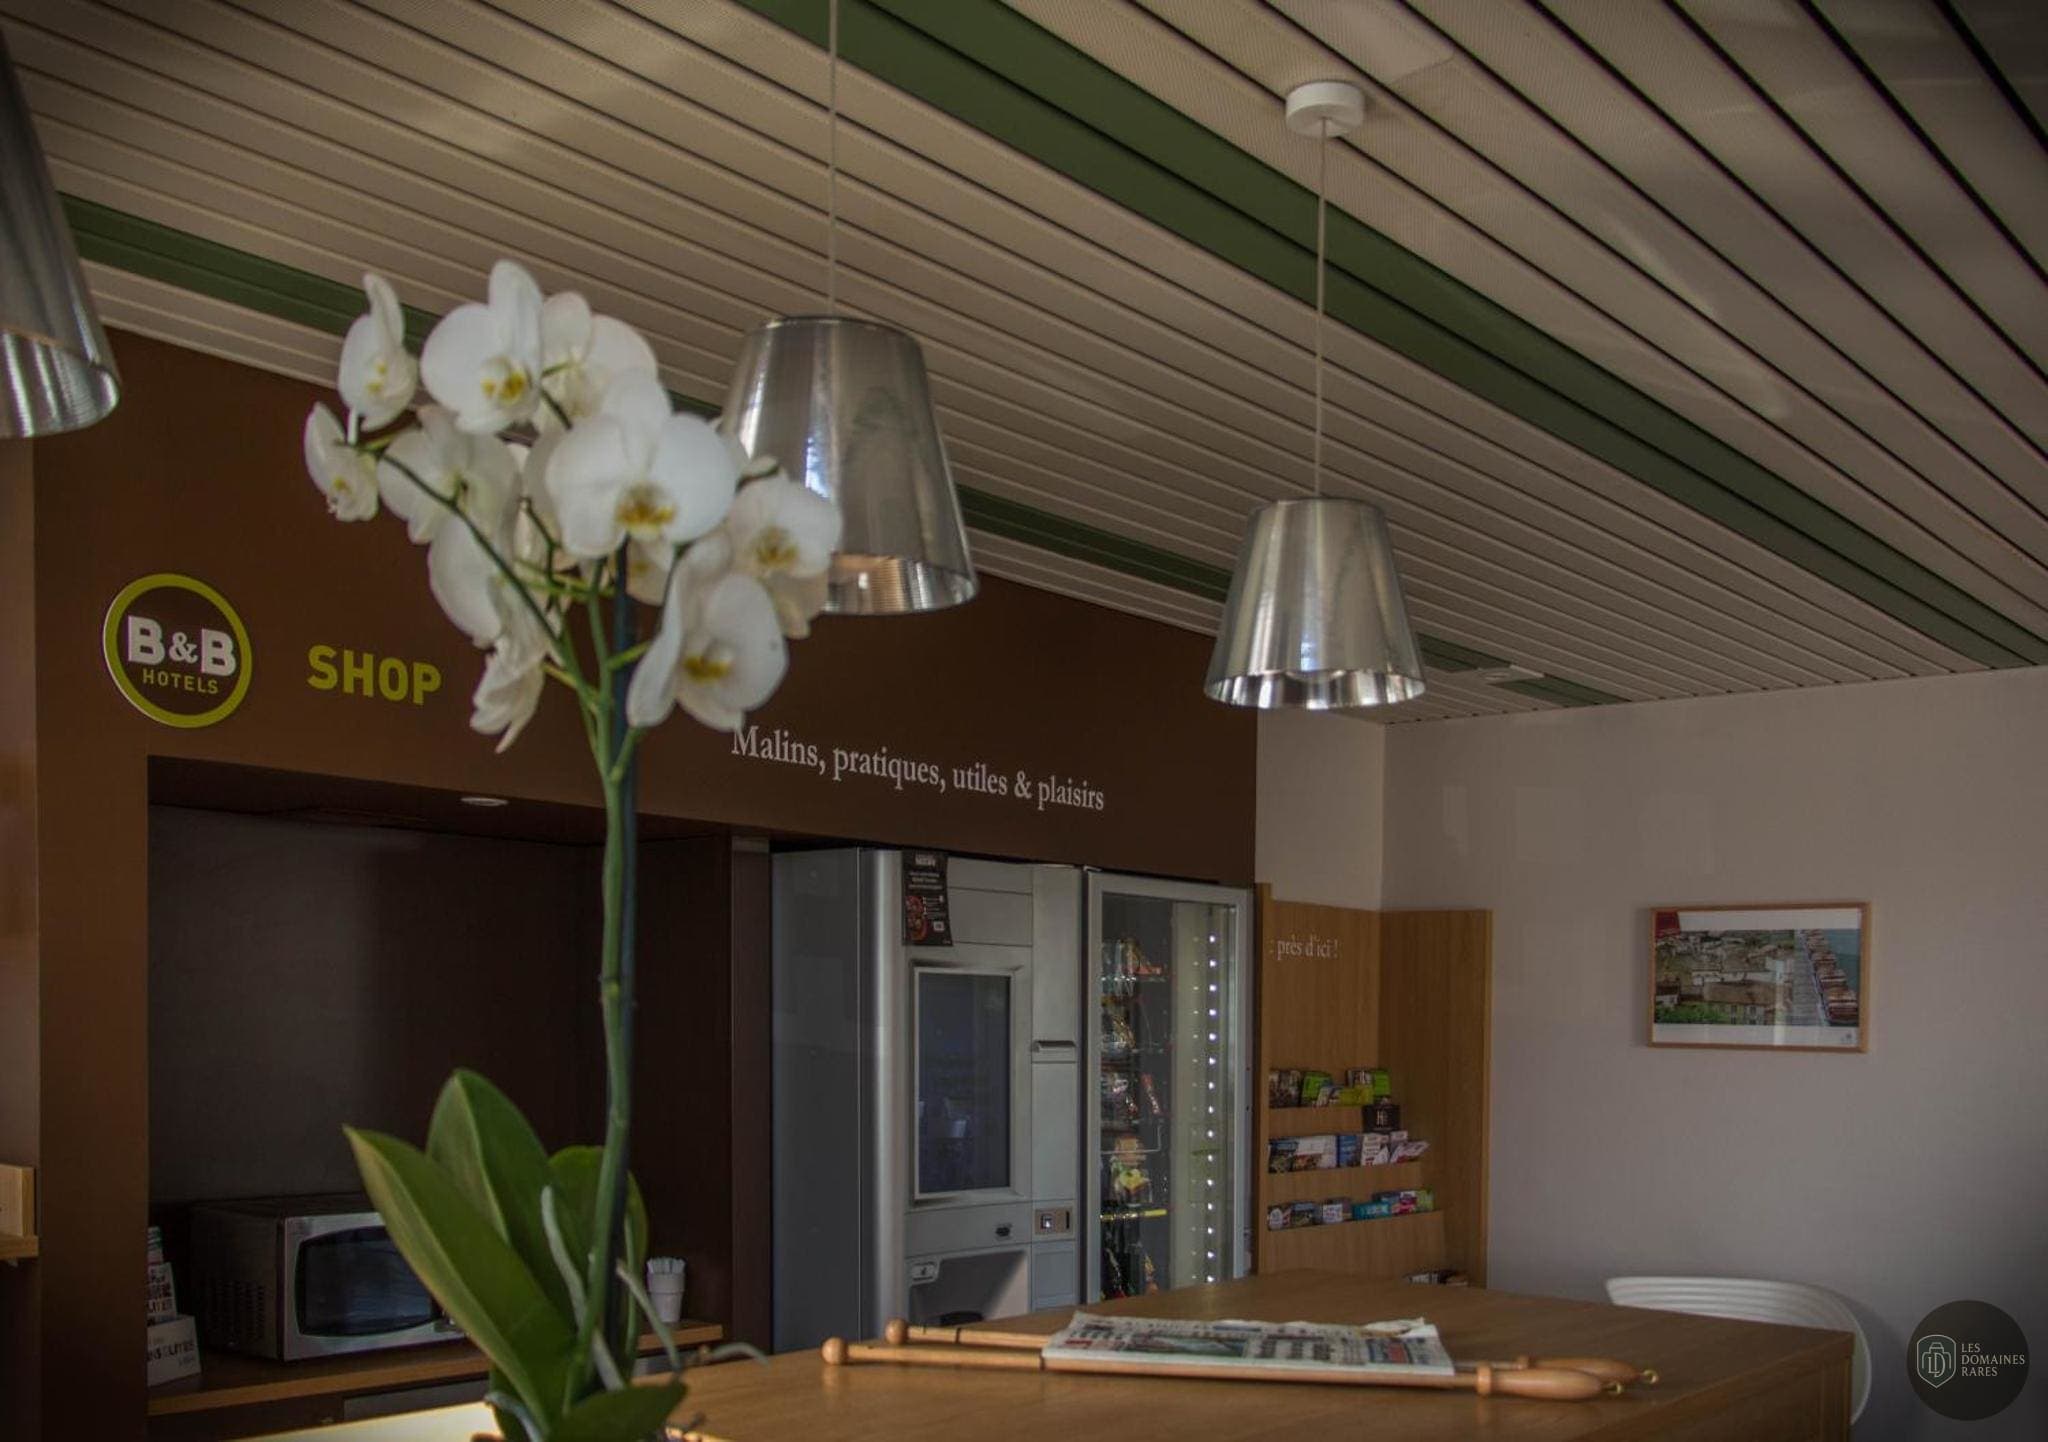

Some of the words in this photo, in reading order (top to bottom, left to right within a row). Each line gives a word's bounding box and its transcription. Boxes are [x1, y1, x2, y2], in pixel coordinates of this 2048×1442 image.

[127, 615, 236, 677] B&B
[307, 645, 442, 705] SHOP
[142, 668, 219, 695] HOTELS
[731, 725, 826, 775] Malins,
[833, 746, 946, 793] pratiques,
[952, 762, 1008, 796] utiles
[1014, 770, 1032, 799] &
[1037, 775, 1104, 811] plaisirs
